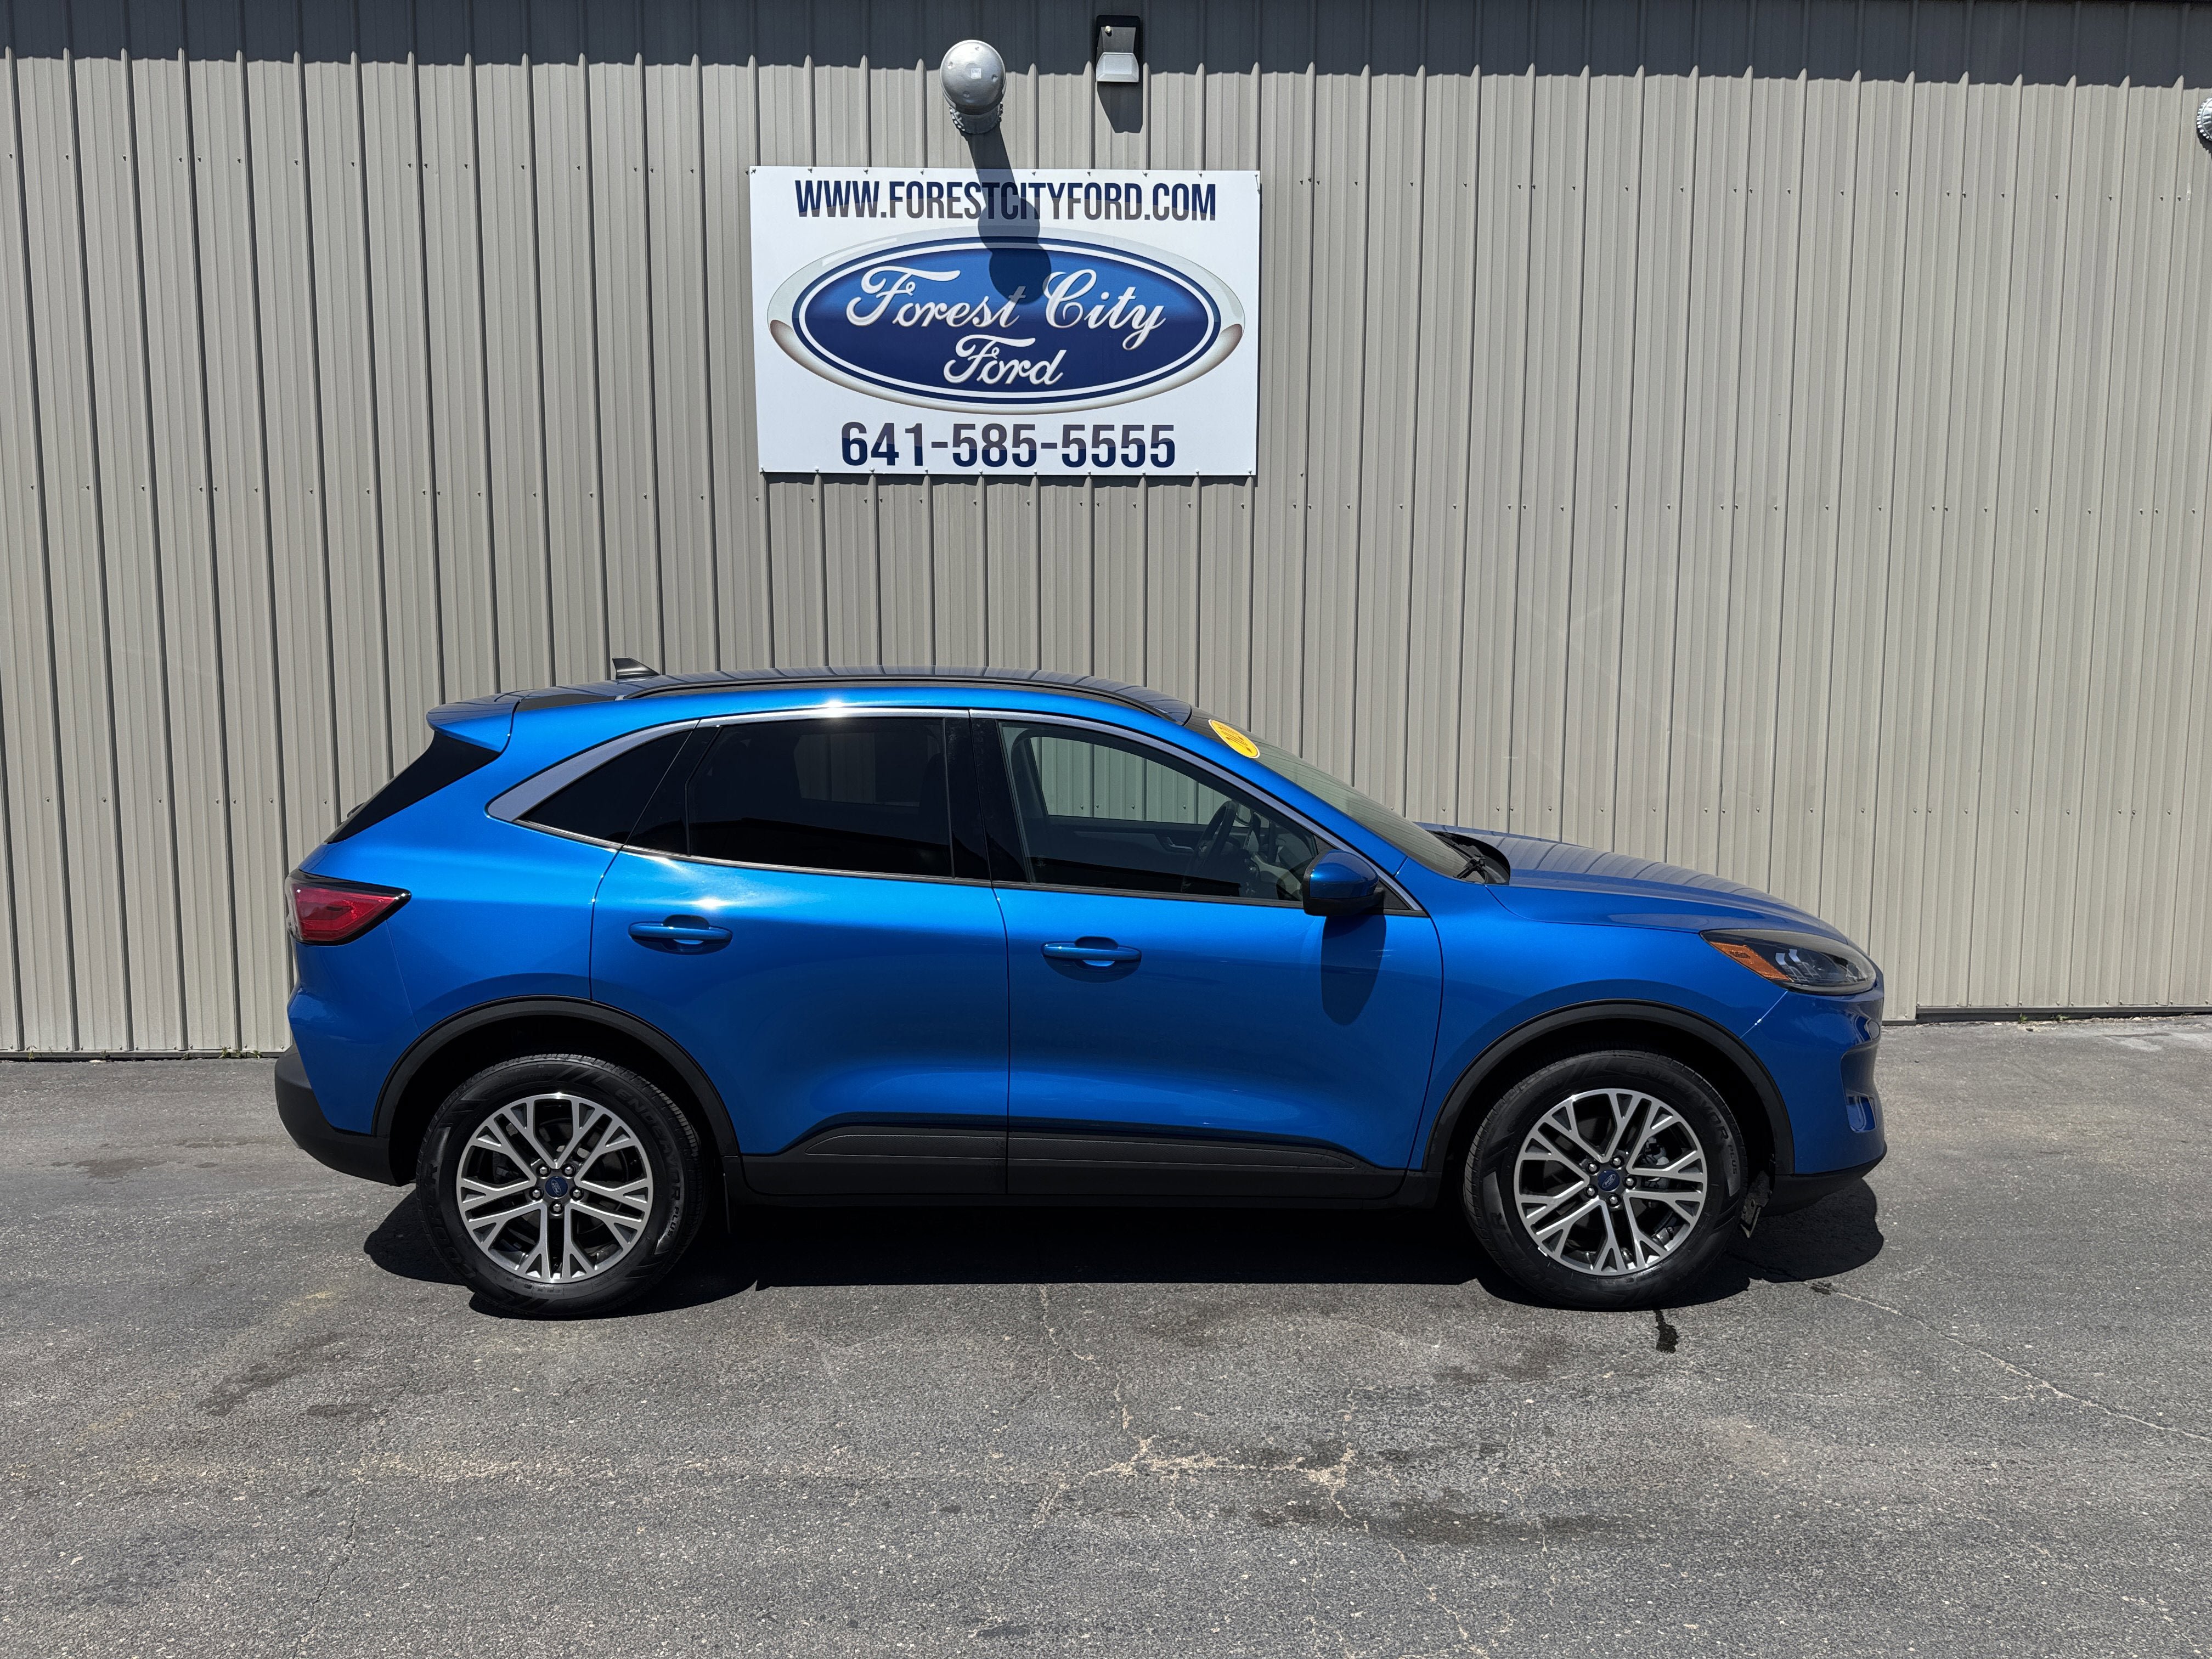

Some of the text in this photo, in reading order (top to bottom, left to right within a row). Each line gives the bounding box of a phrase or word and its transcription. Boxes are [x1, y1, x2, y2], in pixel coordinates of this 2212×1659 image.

[795, 179, 1216, 221] WWW.FORESTCITYFORD.COM
[845, 266, 1166, 351] Forest City
[944, 334, 1067, 386] Ford
[841, 421, 1176, 468] 641-585-5555
[615, 1088, 681, 1237] ENDEAVOR PLUS
[1728, 1144, 1737, 1175] PLUS
